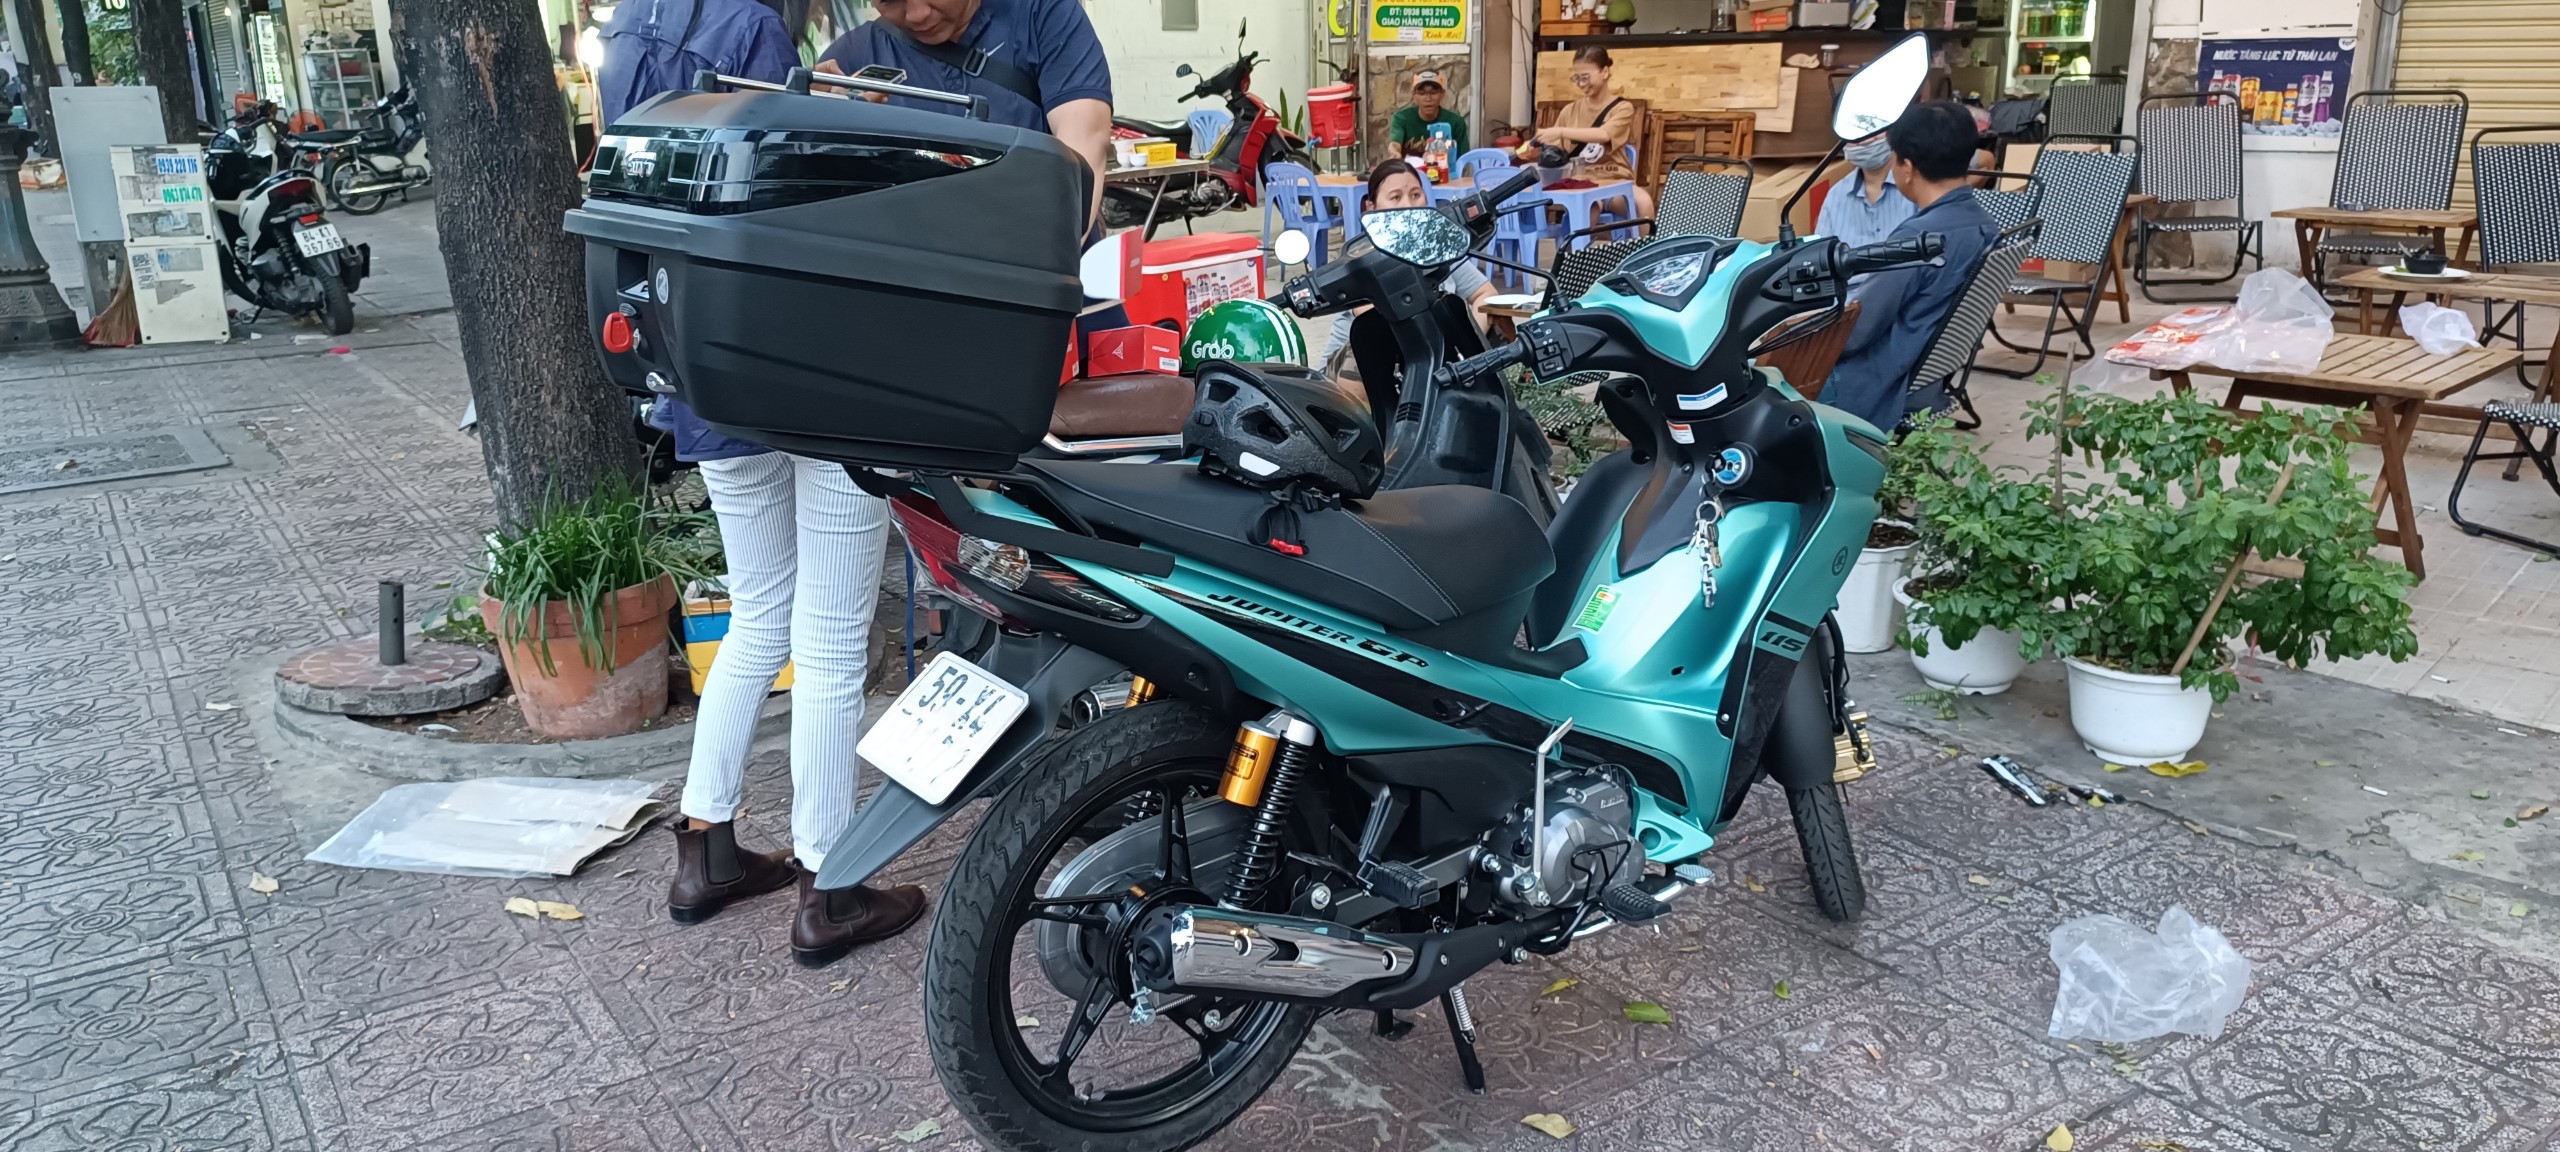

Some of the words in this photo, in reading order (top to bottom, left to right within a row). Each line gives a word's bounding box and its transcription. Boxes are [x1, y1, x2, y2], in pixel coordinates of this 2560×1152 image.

[1403, 7, 1420, 17] 0938
[1435, 7, 1448, 16] 214
[1381, 17, 1400, 26] GIAO
[1401, 15, 1424, 27] HÀNG
[2317, 50, 2340, 61] LAN
[1191, 338, 1235, 360] Grab
[1206, 593, 1356, 645] JUPITER
[1356, 636, 1430, 669] GP
[1760, 631, 1807, 652] 115
